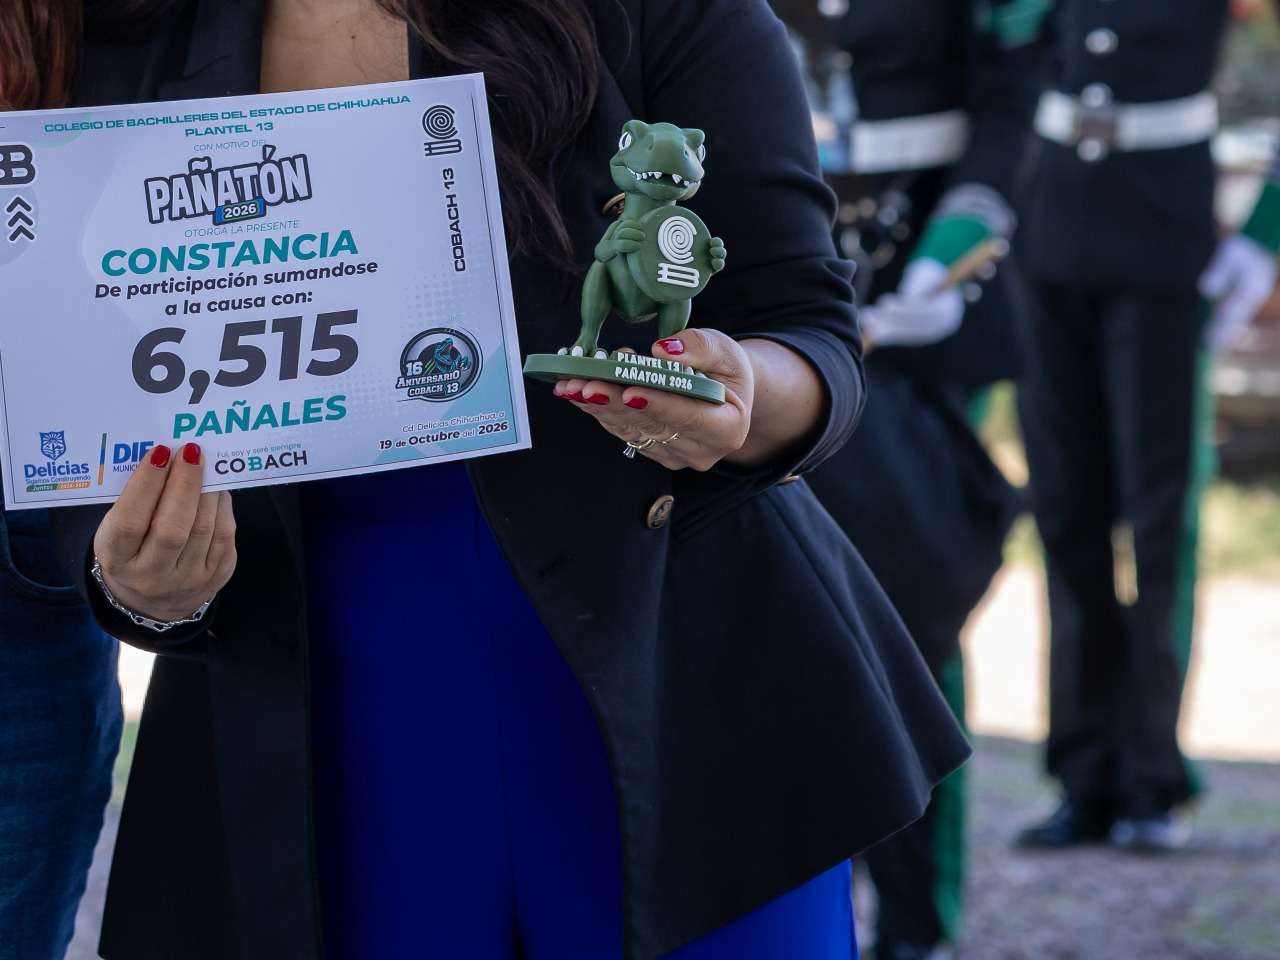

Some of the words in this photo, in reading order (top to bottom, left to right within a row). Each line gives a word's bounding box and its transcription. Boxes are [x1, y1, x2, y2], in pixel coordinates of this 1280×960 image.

[45, 121, 103, 133] COLEGIO
[106, 120, 124, 128] DE
[127, 113, 218, 127] BACHILLERES
[221, 111, 247, 120] DEL
[250, 105, 305, 118] ESTADO
[307, 103, 325, 113] DE
[327, 95, 411, 111] CHIHUAHUA
[185, 124, 252, 137] PLANTEL
[256, 122, 274, 131] 13
[194, 143, 213, 151] CON
[216, 140, 249, 150] MOTIVO
[144, 145, 312, 224] PAÑATÓN
[443, 167, 455, 190] 13
[224, 204, 257, 218] 2026
[184, 226, 228, 238] OTORGA
[231, 225, 243, 234] LA
[246, 220, 300, 232] PRESENTE
[446, 194, 466, 272] COBACH
[101, 230, 358, 277] CONSTANCIA
[95, 283, 120, 298] De
[127, 272, 257, 299] participación
[263, 259, 378, 285] sumandose
[165, 303, 177, 316] a
[183, 299, 201, 314] la
[207, 295, 266, 312] causa
[272, 290, 313, 305] con:
[131, 309, 359, 405] 6,515
[405, 361, 423, 376] 16
[617, 352, 662, 369] PLANTEL
[667, 361, 680, 371] 13
[397, 370, 460, 387] ANIVERSARIO
[408, 384, 443, 396] COBACH
[446, 382, 459, 394] 13
[615, 367, 666, 386] PAÑATON
[669, 376, 693, 390] 2026
[173, 395, 346, 439] PAÑALES
[418, 421, 449, 431] Delicias
[379, 440, 392, 449] 19
[396, 440, 406, 448] de
[409, 431, 460, 446] Octubre
[463, 430, 475, 438] del
[478, 422, 508, 434] 2026
[24, 461, 90, 478] Delicias
[215, 450, 308, 474] COBACH
